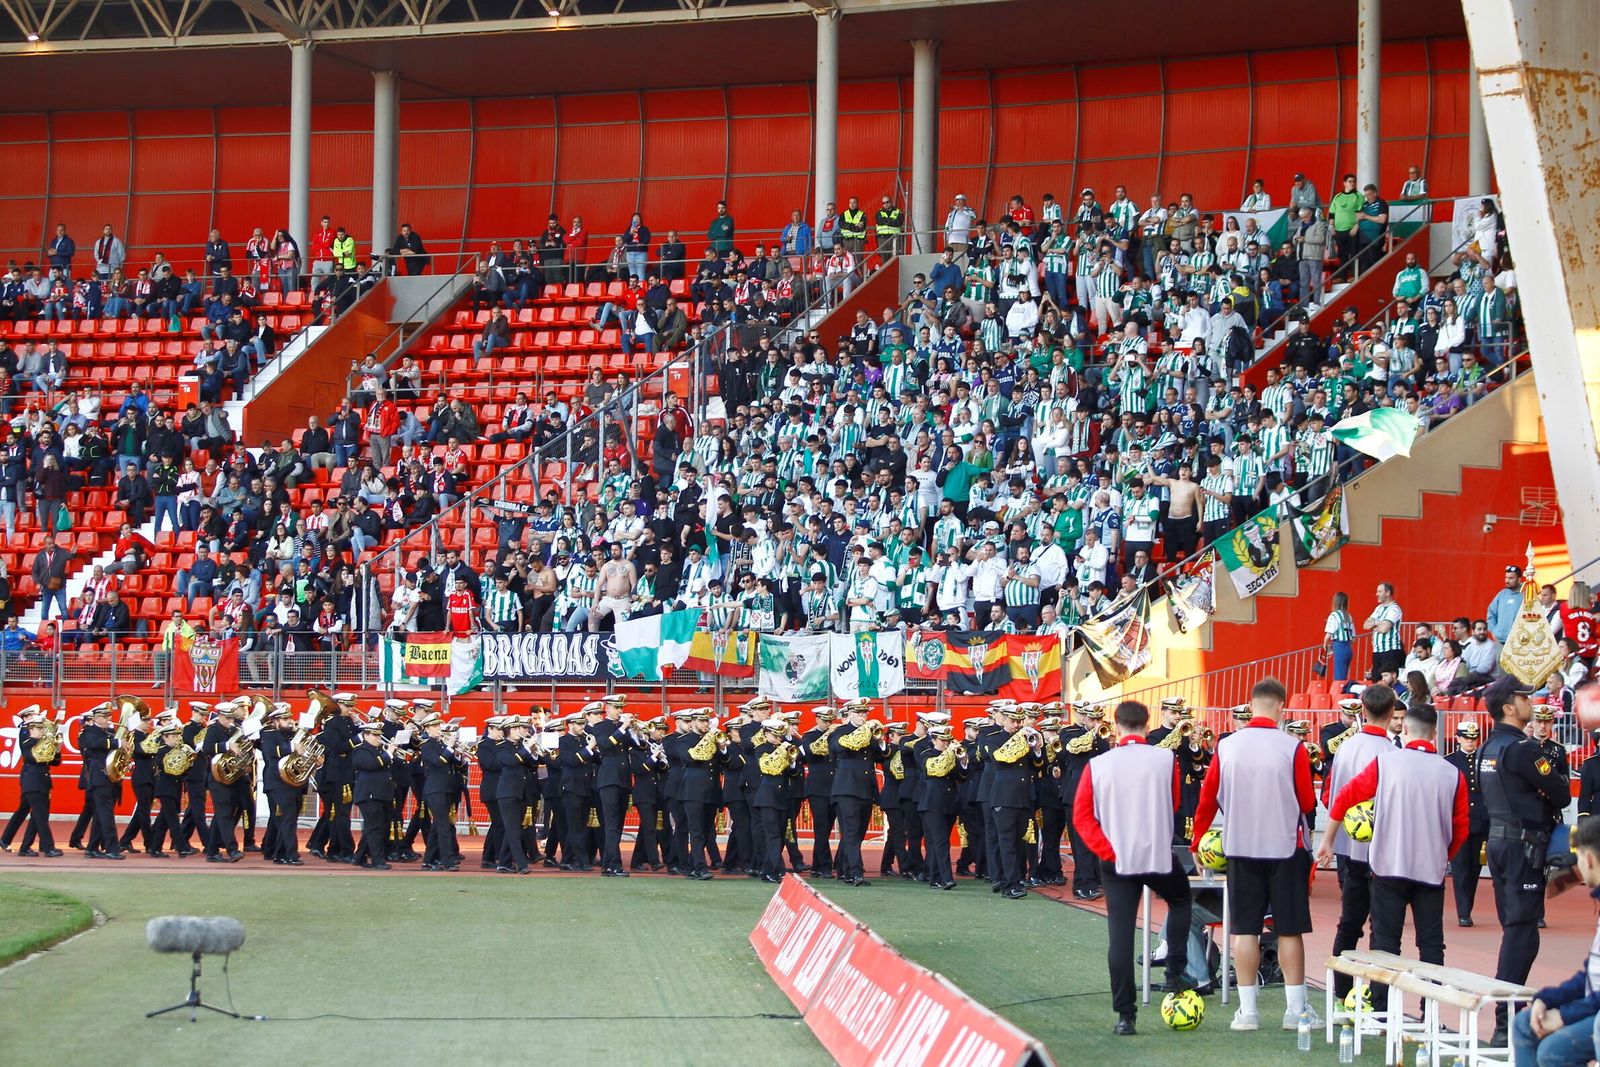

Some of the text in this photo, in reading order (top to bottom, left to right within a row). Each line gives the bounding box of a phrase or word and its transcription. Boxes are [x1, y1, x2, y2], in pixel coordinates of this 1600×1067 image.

[409, 645, 448, 662] Baena
[482, 633, 600, 677] BRIGADAS
[1517, 657, 1545, 667] CARMEN
